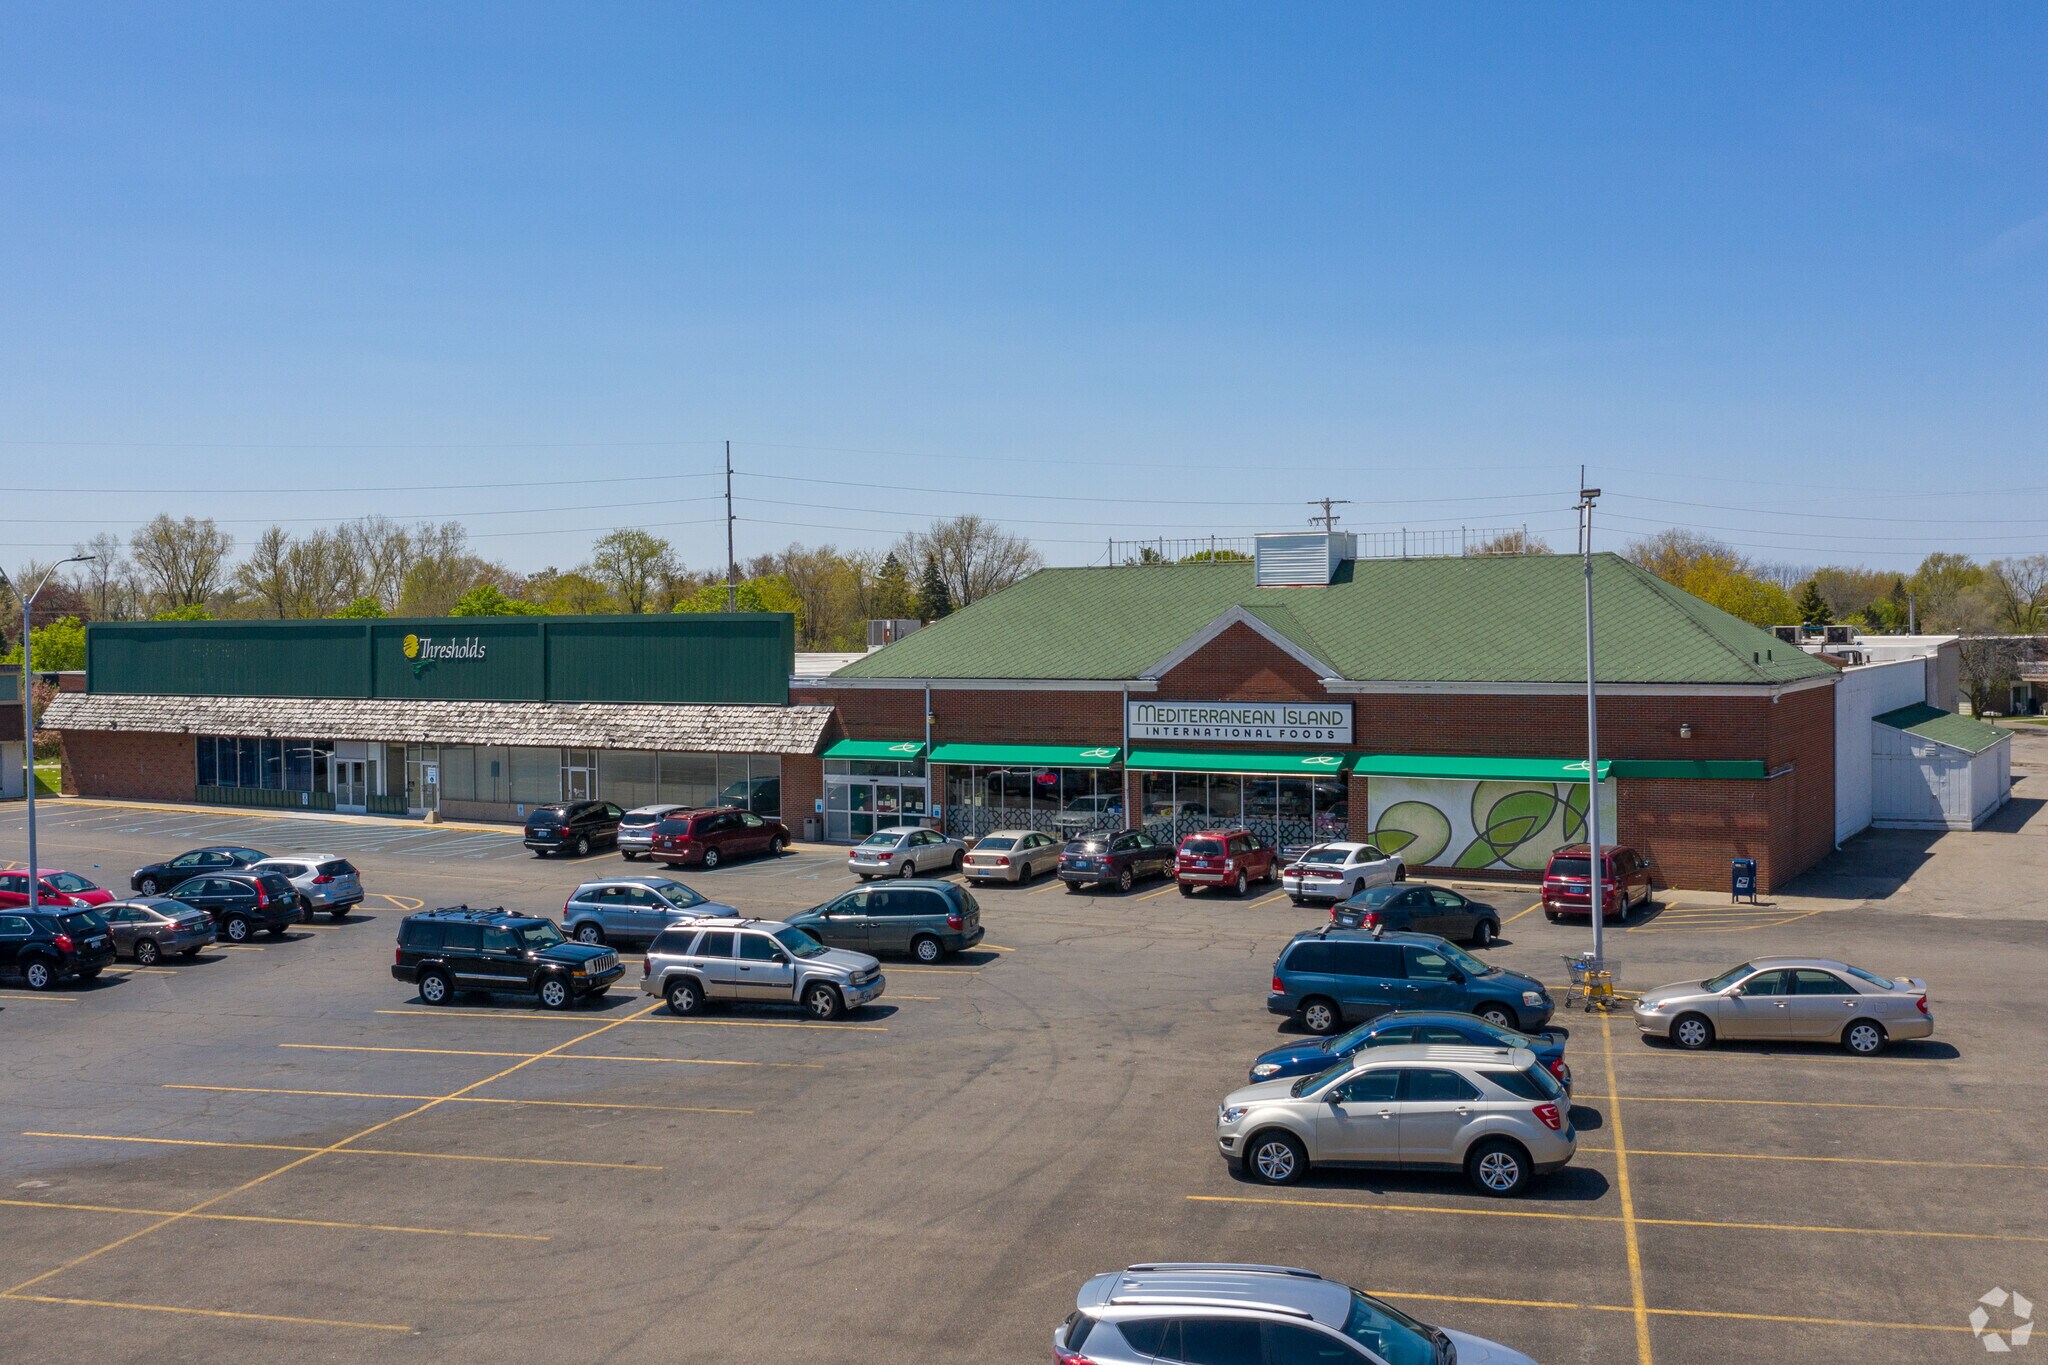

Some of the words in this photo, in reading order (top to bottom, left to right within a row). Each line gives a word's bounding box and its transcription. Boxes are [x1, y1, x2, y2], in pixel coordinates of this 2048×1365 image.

[419, 637, 486, 659] Thresholds
[1137, 704, 1275, 725] MEDITERRANEAN
[1283, 706, 1344, 726] ISLAND
[1146, 726, 1272, 738] INTERNATIONAL
[1279, 729, 1335, 739] FOODS
[1037, 774, 1057, 783] OPEN
